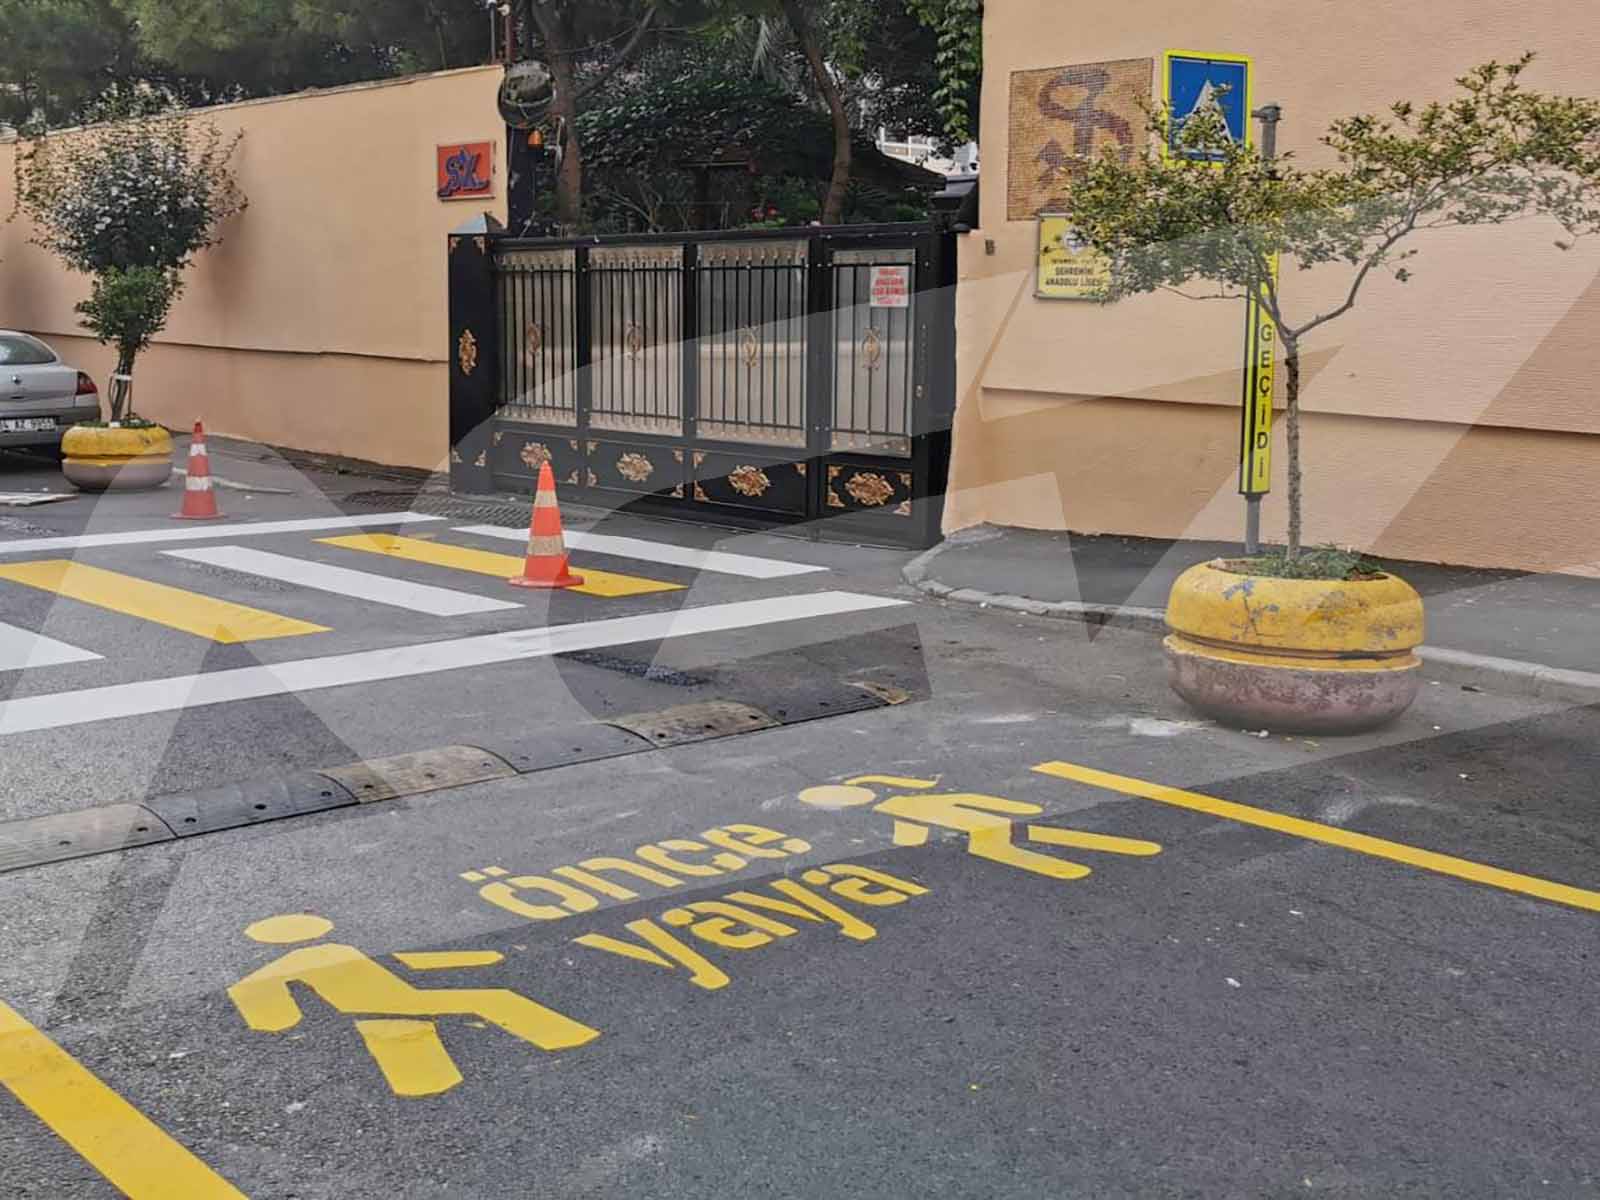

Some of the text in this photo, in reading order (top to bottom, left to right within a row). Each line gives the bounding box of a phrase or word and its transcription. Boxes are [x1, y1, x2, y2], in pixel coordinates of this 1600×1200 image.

[1256, 323, 1273, 479] GEÇİDİ
[459, 823, 812, 919] önce
[572, 864, 931, 990] yaya
